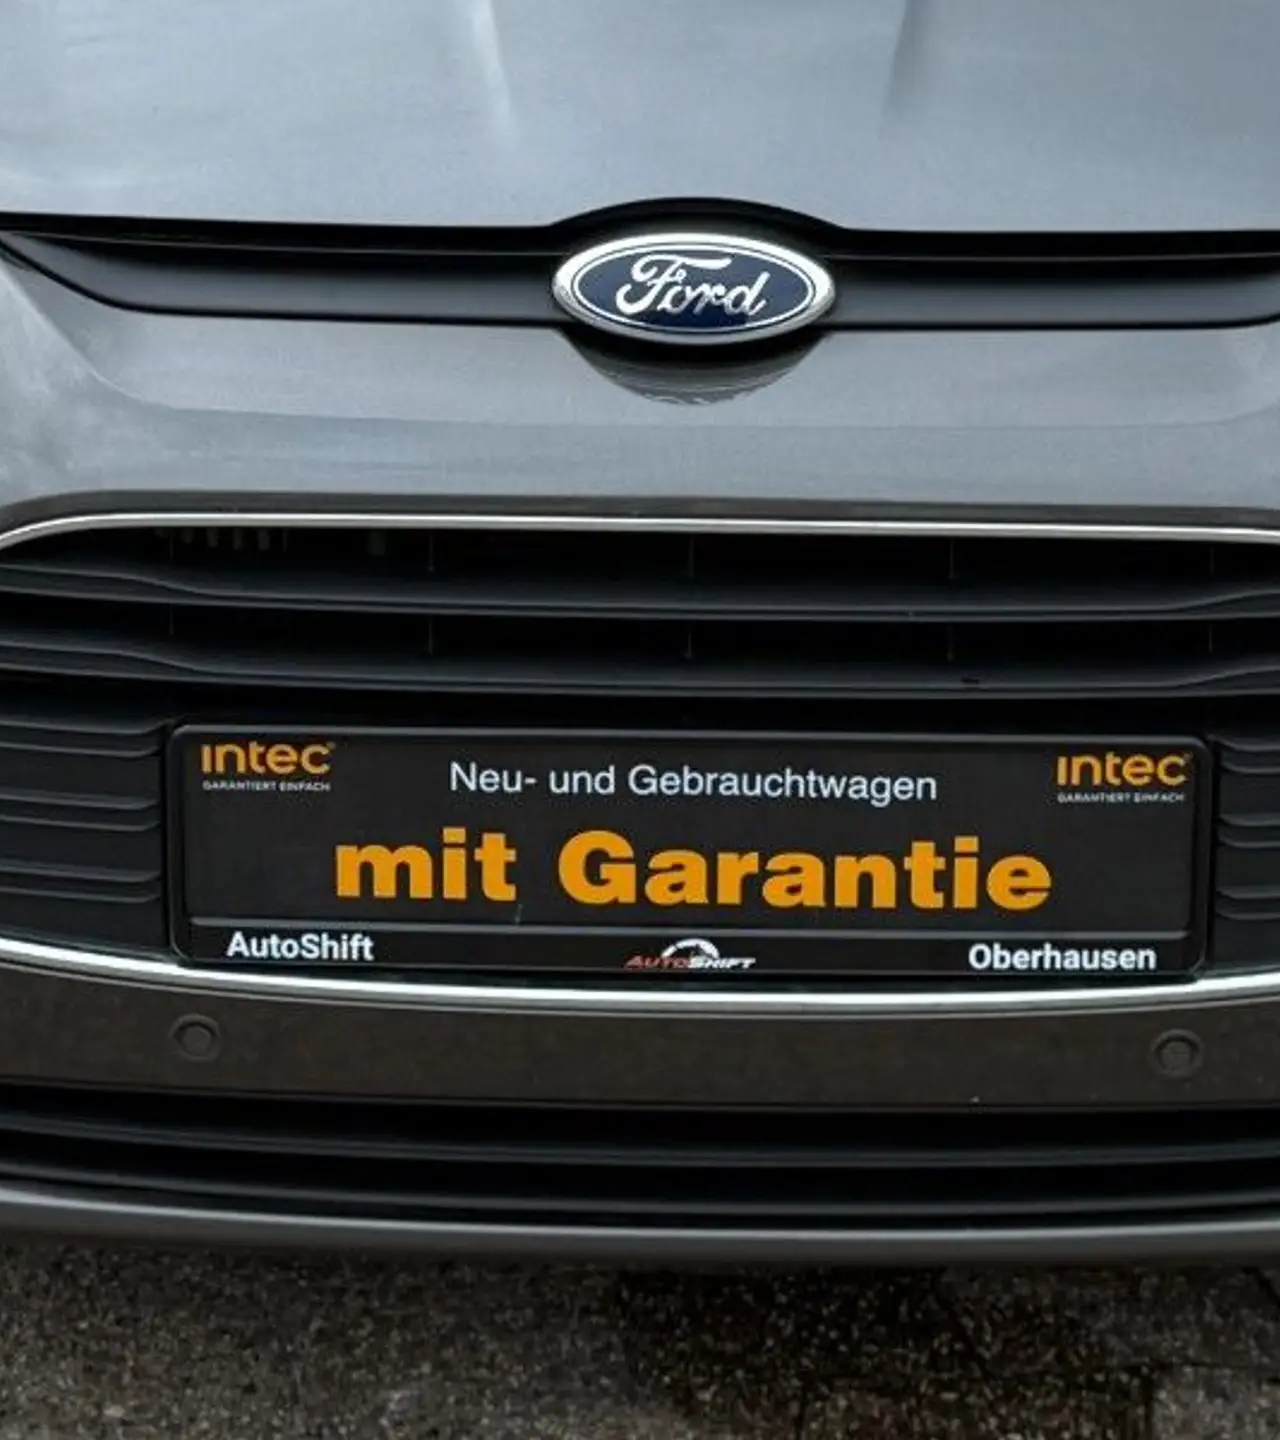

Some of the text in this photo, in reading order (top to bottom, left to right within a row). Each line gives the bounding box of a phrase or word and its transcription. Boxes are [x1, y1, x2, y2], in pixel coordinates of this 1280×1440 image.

[615, 253, 770, 316] Ford
[202, 780, 277, 791] GARANTIERT
[450, 762, 938, 808] Neu- und Gebrauchtwagen
[334, 826, 1053, 911] mit Garantie
[225, 931, 374, 962] AutoShift
[968, 943, 1157, 972] Oberhausen
